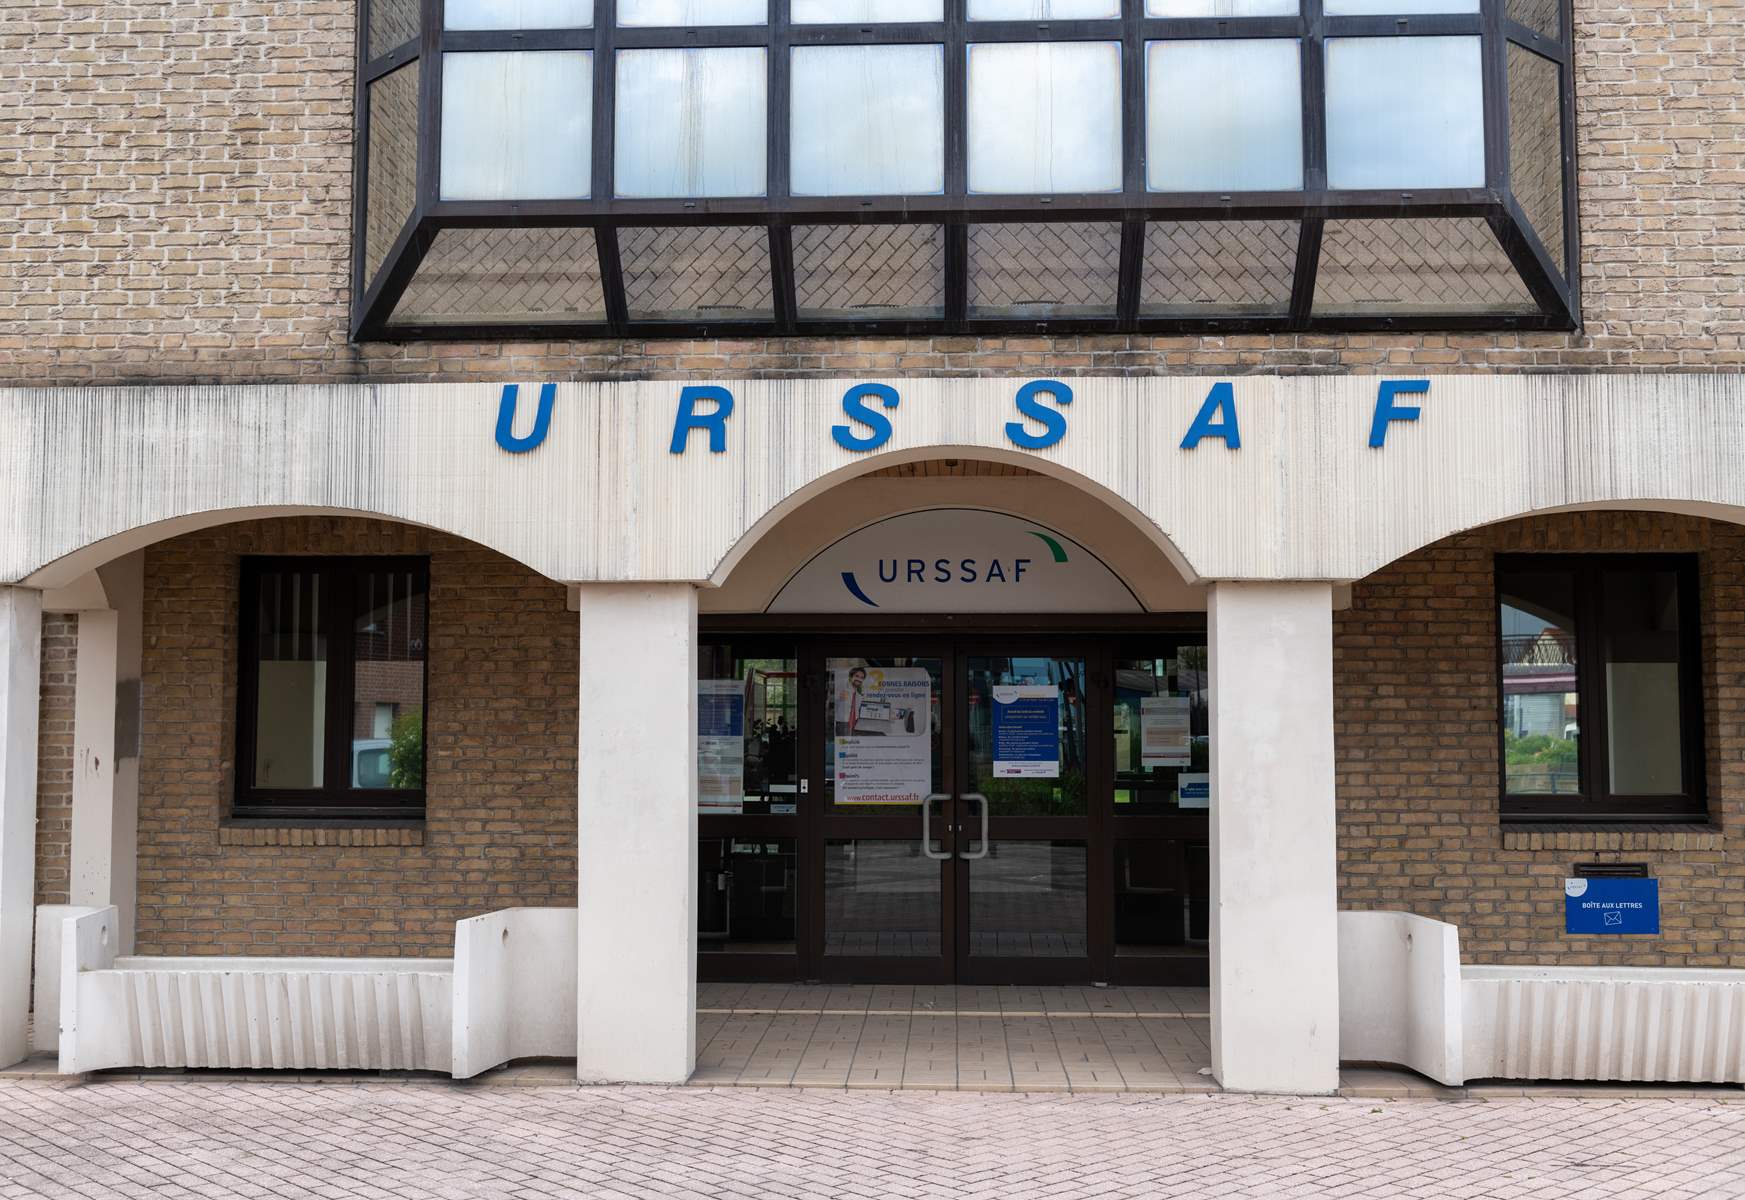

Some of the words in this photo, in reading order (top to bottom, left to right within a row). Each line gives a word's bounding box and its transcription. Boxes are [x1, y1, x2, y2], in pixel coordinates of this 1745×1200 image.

[496, 378, 1430, 453] URSSAF
[879, 558, 1032, 583] URSSAF
[847, 792, 919, 801] www.contact.urssaf.fr
[1582, 901, 1601, 909] BOÎTE
